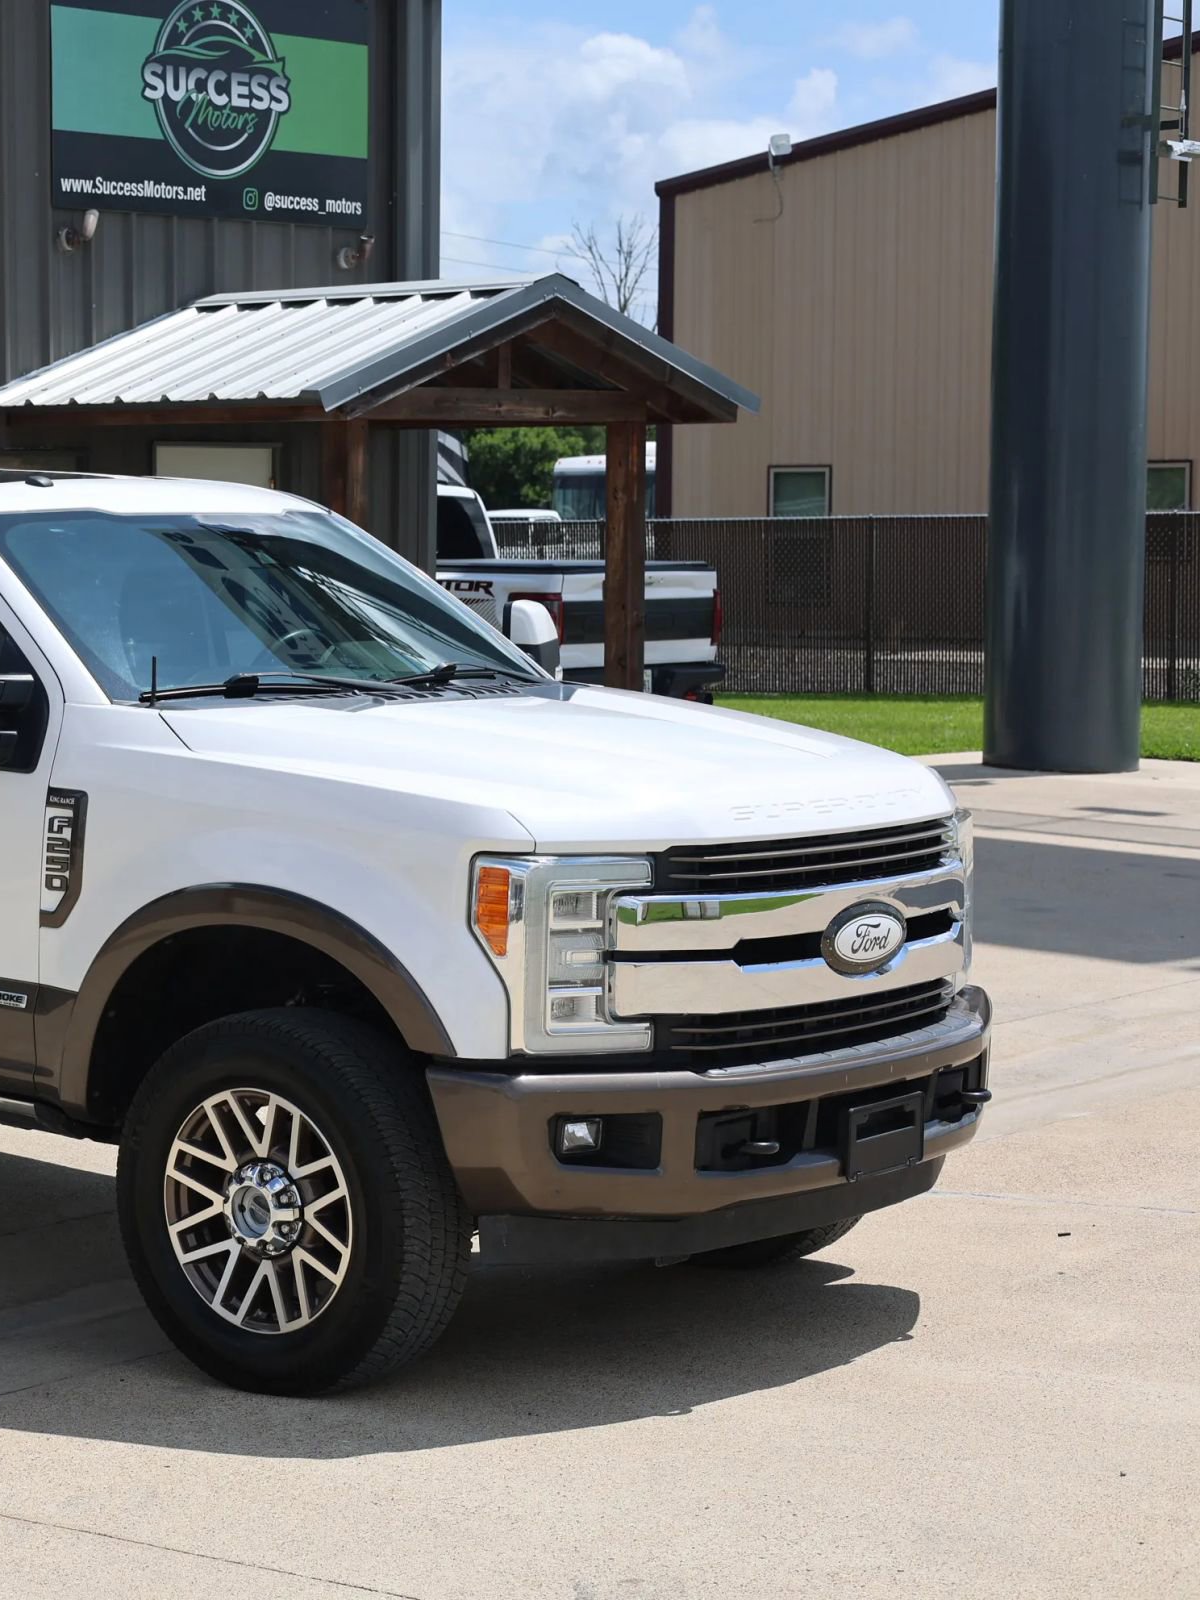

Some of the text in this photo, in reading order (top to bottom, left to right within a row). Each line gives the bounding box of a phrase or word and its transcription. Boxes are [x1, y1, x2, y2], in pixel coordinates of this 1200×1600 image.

[143, 62, 289, 112] SUCCESS
[176, 88, 258, 133] Motors
[60, 176, 206, 201] www.SuccessMotors.net
[264, 191, 362, 215] @success_motors
[437, 580, 495, 598] TOR
[45, 815, 73, 892] F250
[851, 923, 890, 954] Ford
